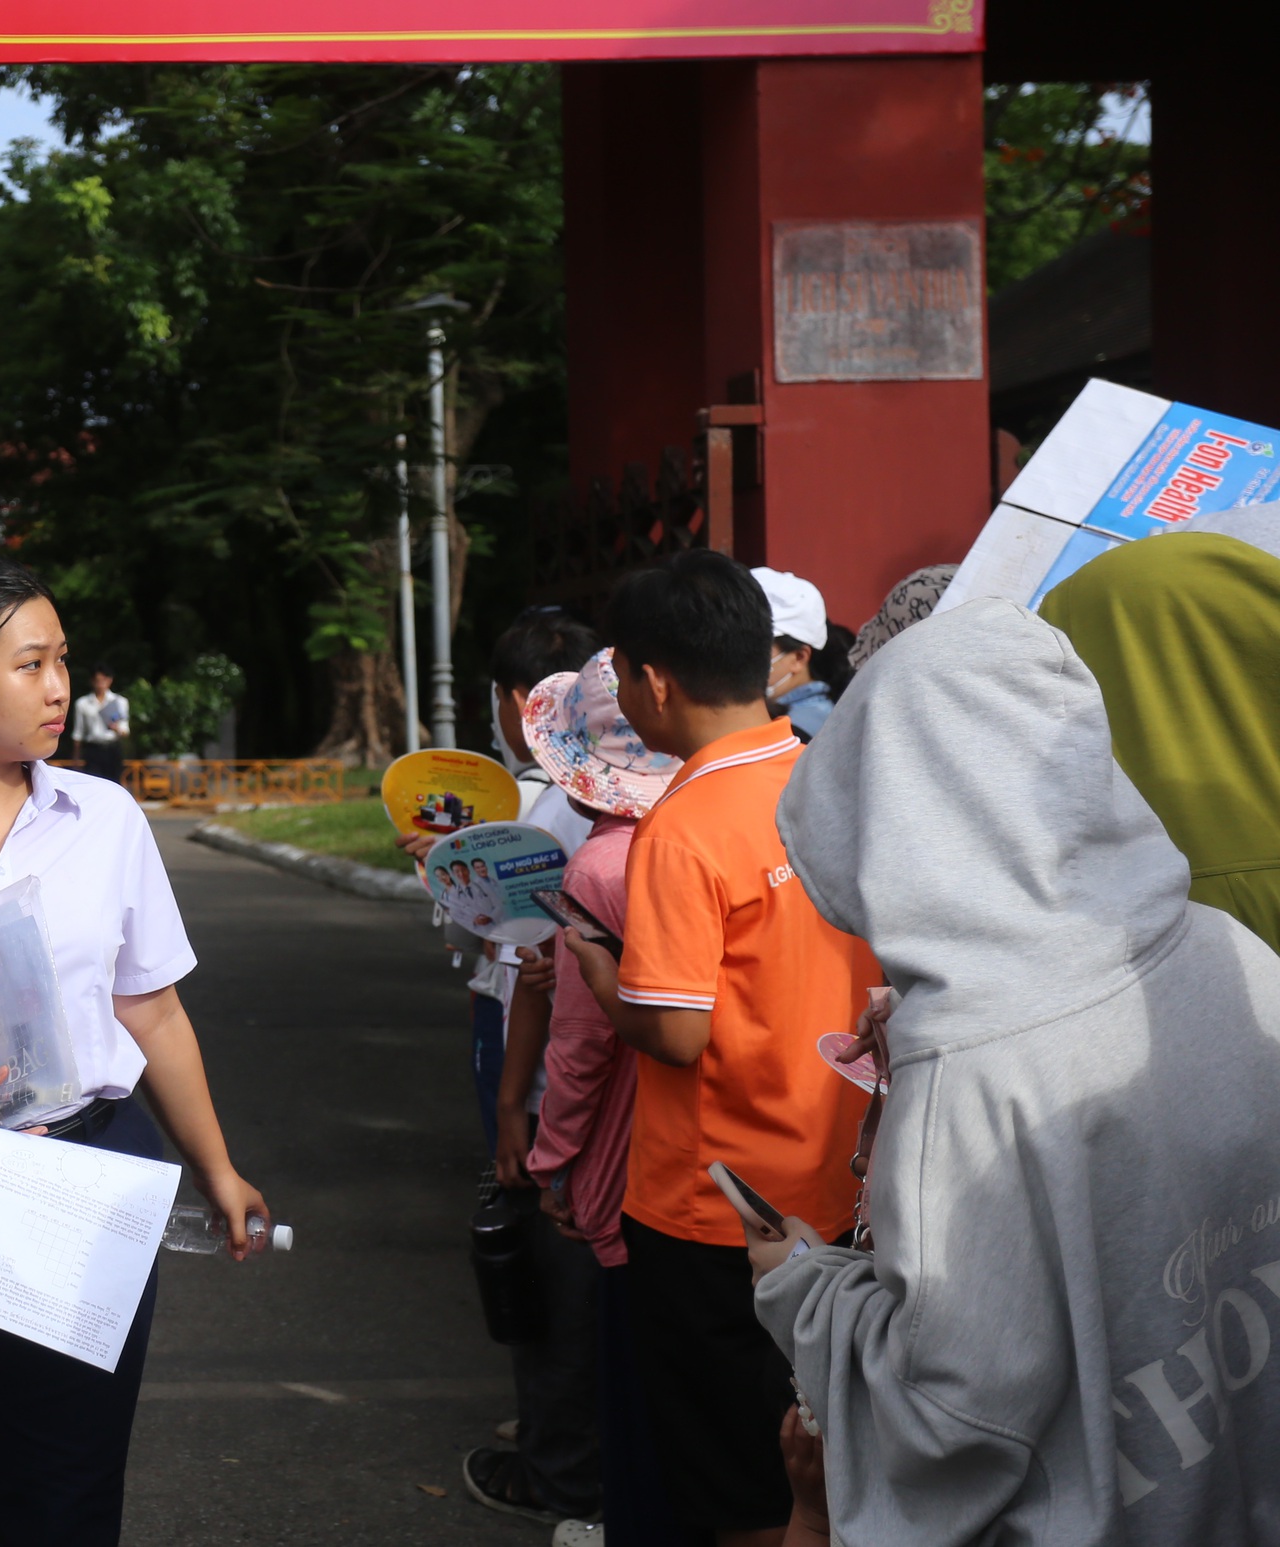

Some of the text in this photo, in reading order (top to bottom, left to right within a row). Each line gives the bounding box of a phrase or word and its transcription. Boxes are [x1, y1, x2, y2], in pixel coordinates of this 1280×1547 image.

[1187, 429, 1250, 473] I-on
[1143, 465, 1225, 524] Health
[471, 838, 497, 852] LONG
